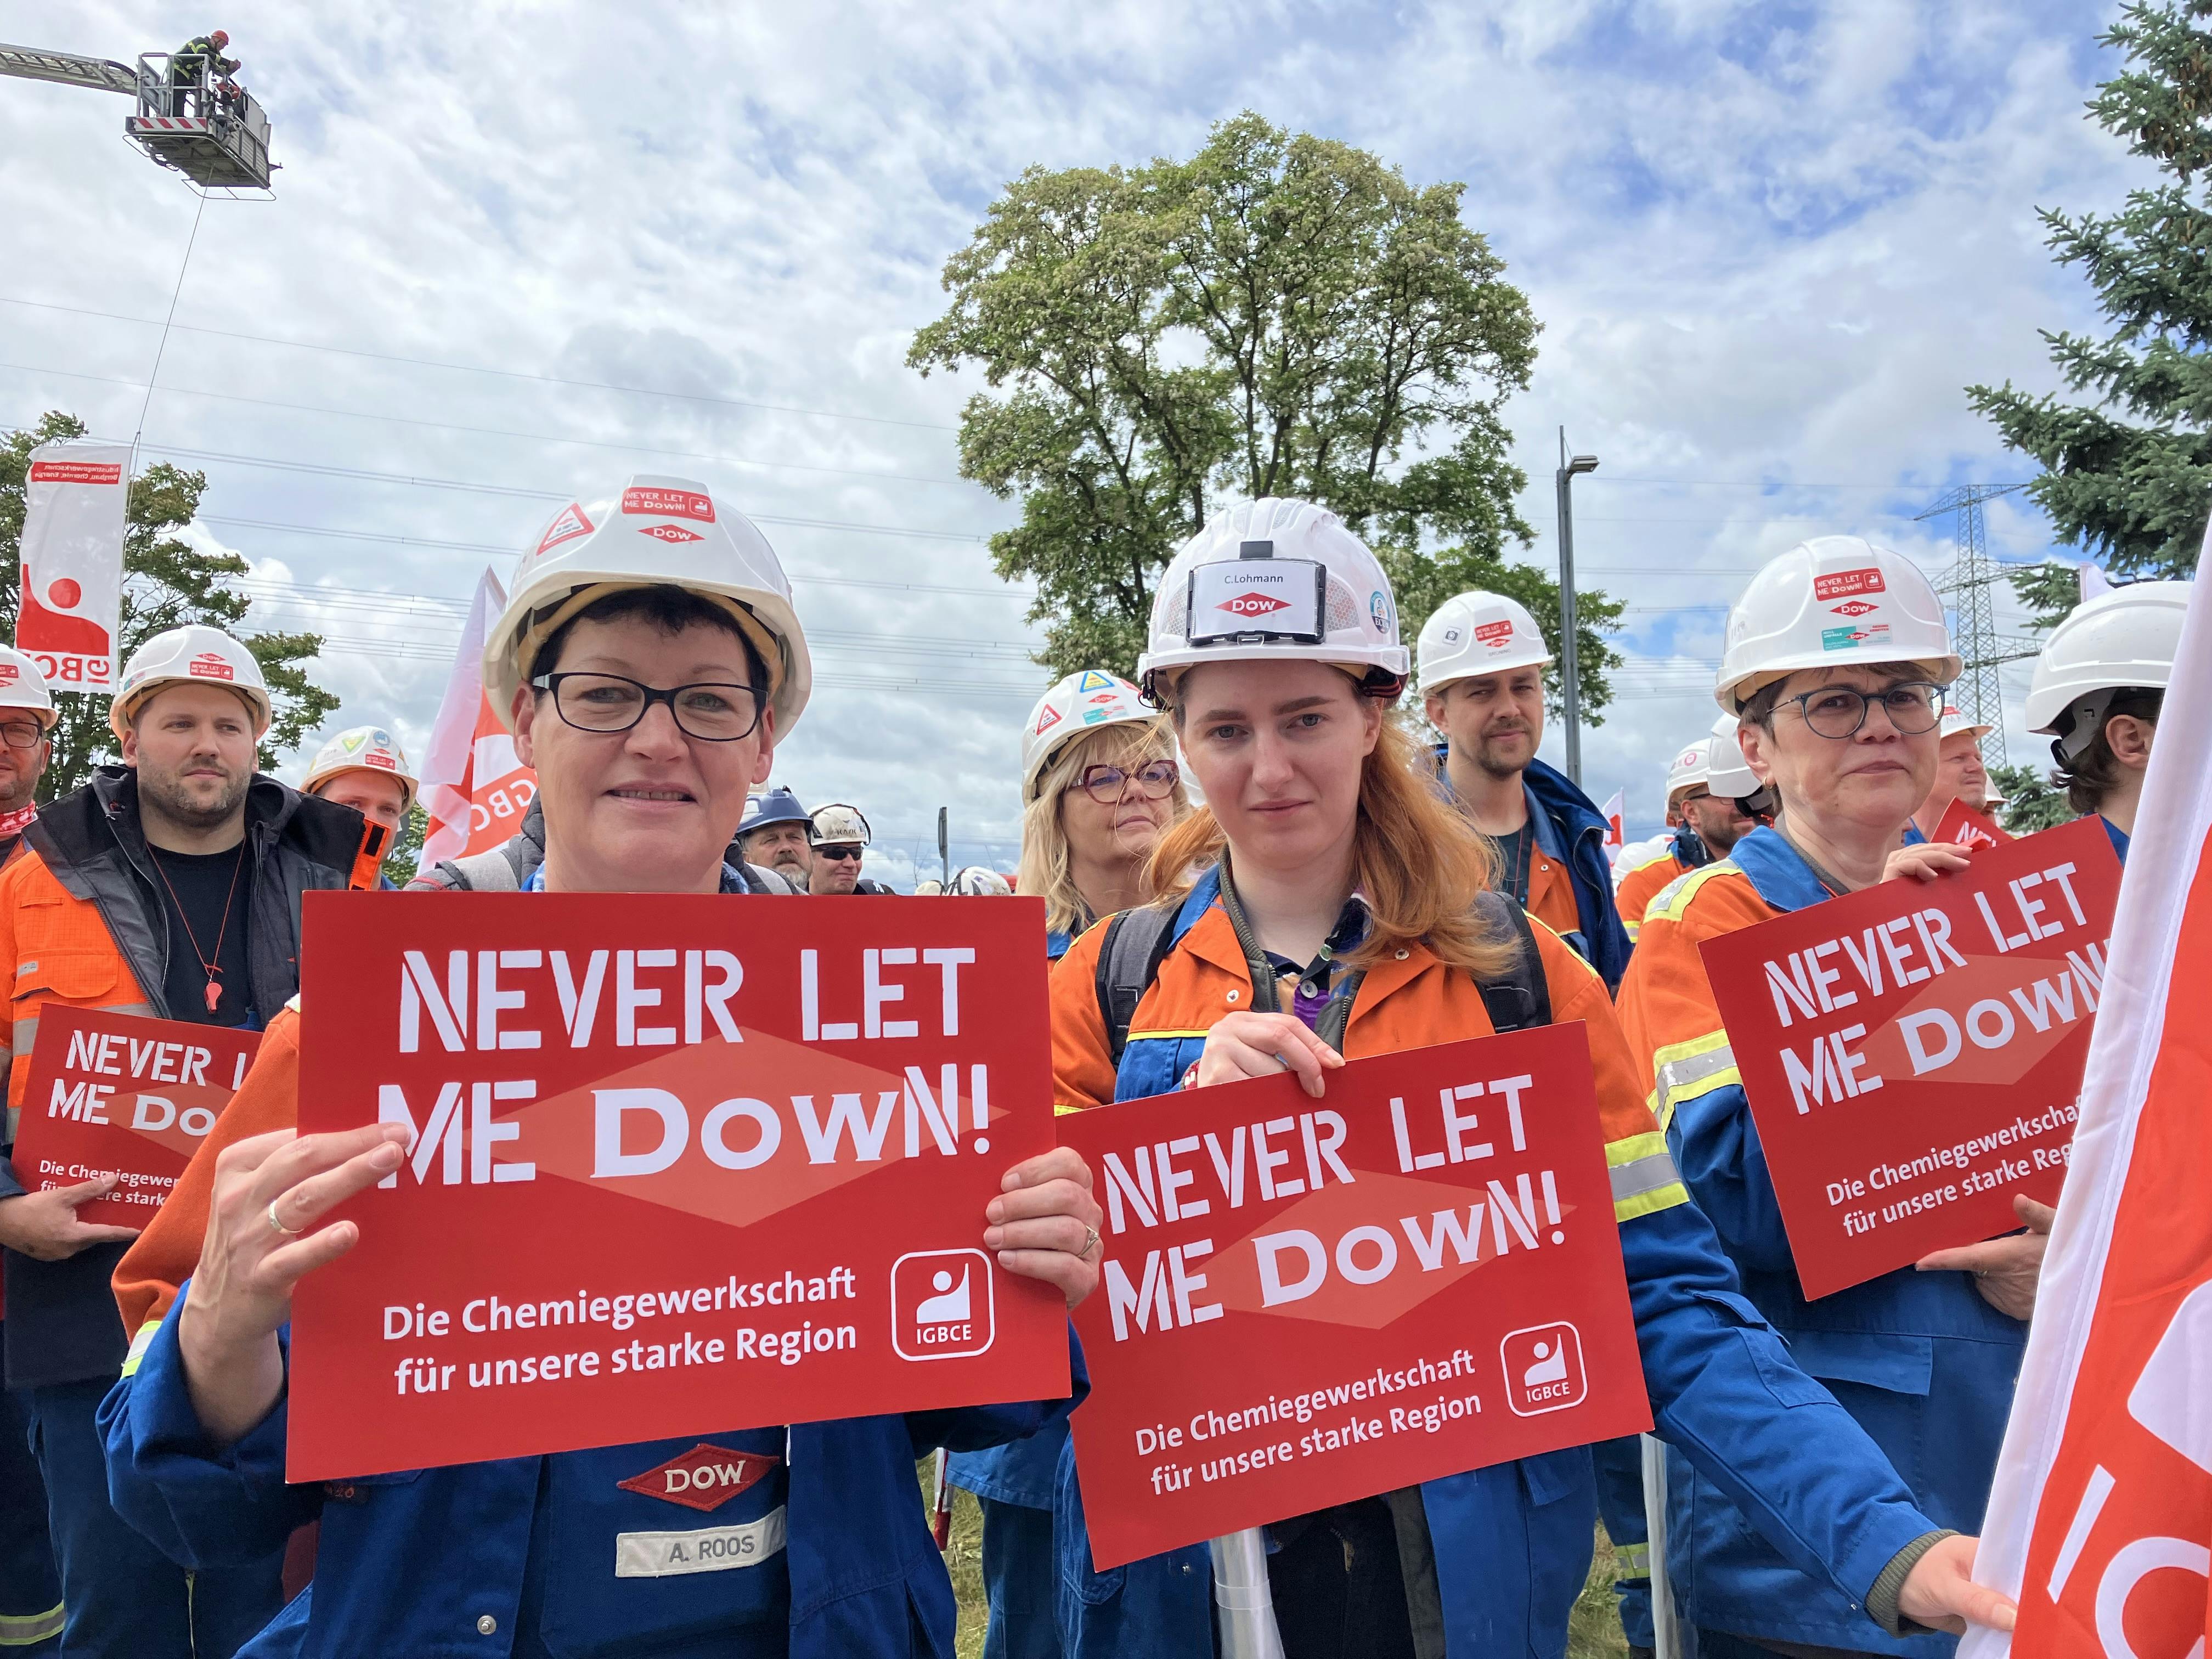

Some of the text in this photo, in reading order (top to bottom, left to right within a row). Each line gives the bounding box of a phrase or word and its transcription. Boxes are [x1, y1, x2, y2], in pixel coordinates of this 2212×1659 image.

[664, 494, 684, 502] LET
[1224, 574, 1283, 584] C.Lohmann
[1817, 574, 1860, 588] NEVER LET
[1817, 588, 1829, 596] ME
[1764, 862, 2086, 1028] NEVER LET
[399, 948, 975, 1053] NEVER LET
[1779, 938, 2110, 1115] ME DOWN
[65, 1030, 212, 1086] NEVER
[48, 1079, 216, 1137] ME DO
[377, 1063, 990, 1188] ME DOWN!
[40, 1160, 64, 1175] Die
[1103, 1074, 1533, 1234] NEVER LET
[1826, 1095, 2081, 1206] Die Chemiegewerkscha
[125, 1192, 166, 1206] stark
[1843, 1140, 2072, 1237] für unsere starke Reg
[1103, 1170, 1565, 1342] ME DOWN!
[383, 1266, 856, 1340] Die Chemiegewerkschaft
[917, 1324, 972, 1345] IGBCE
[394, 1321, 856, 1395] für unsere starke Region
[1136, 1350, 1475, 1455] Die Chemiegewerkschaft
[1526, 1382, 1570, 1403] IGBCE
[664, 1460, 746, 1493] DOW
[1150, 1395, 1481, 1495] für unsere starke Region
[669, 1535, 755, 1562] A. ROOS
